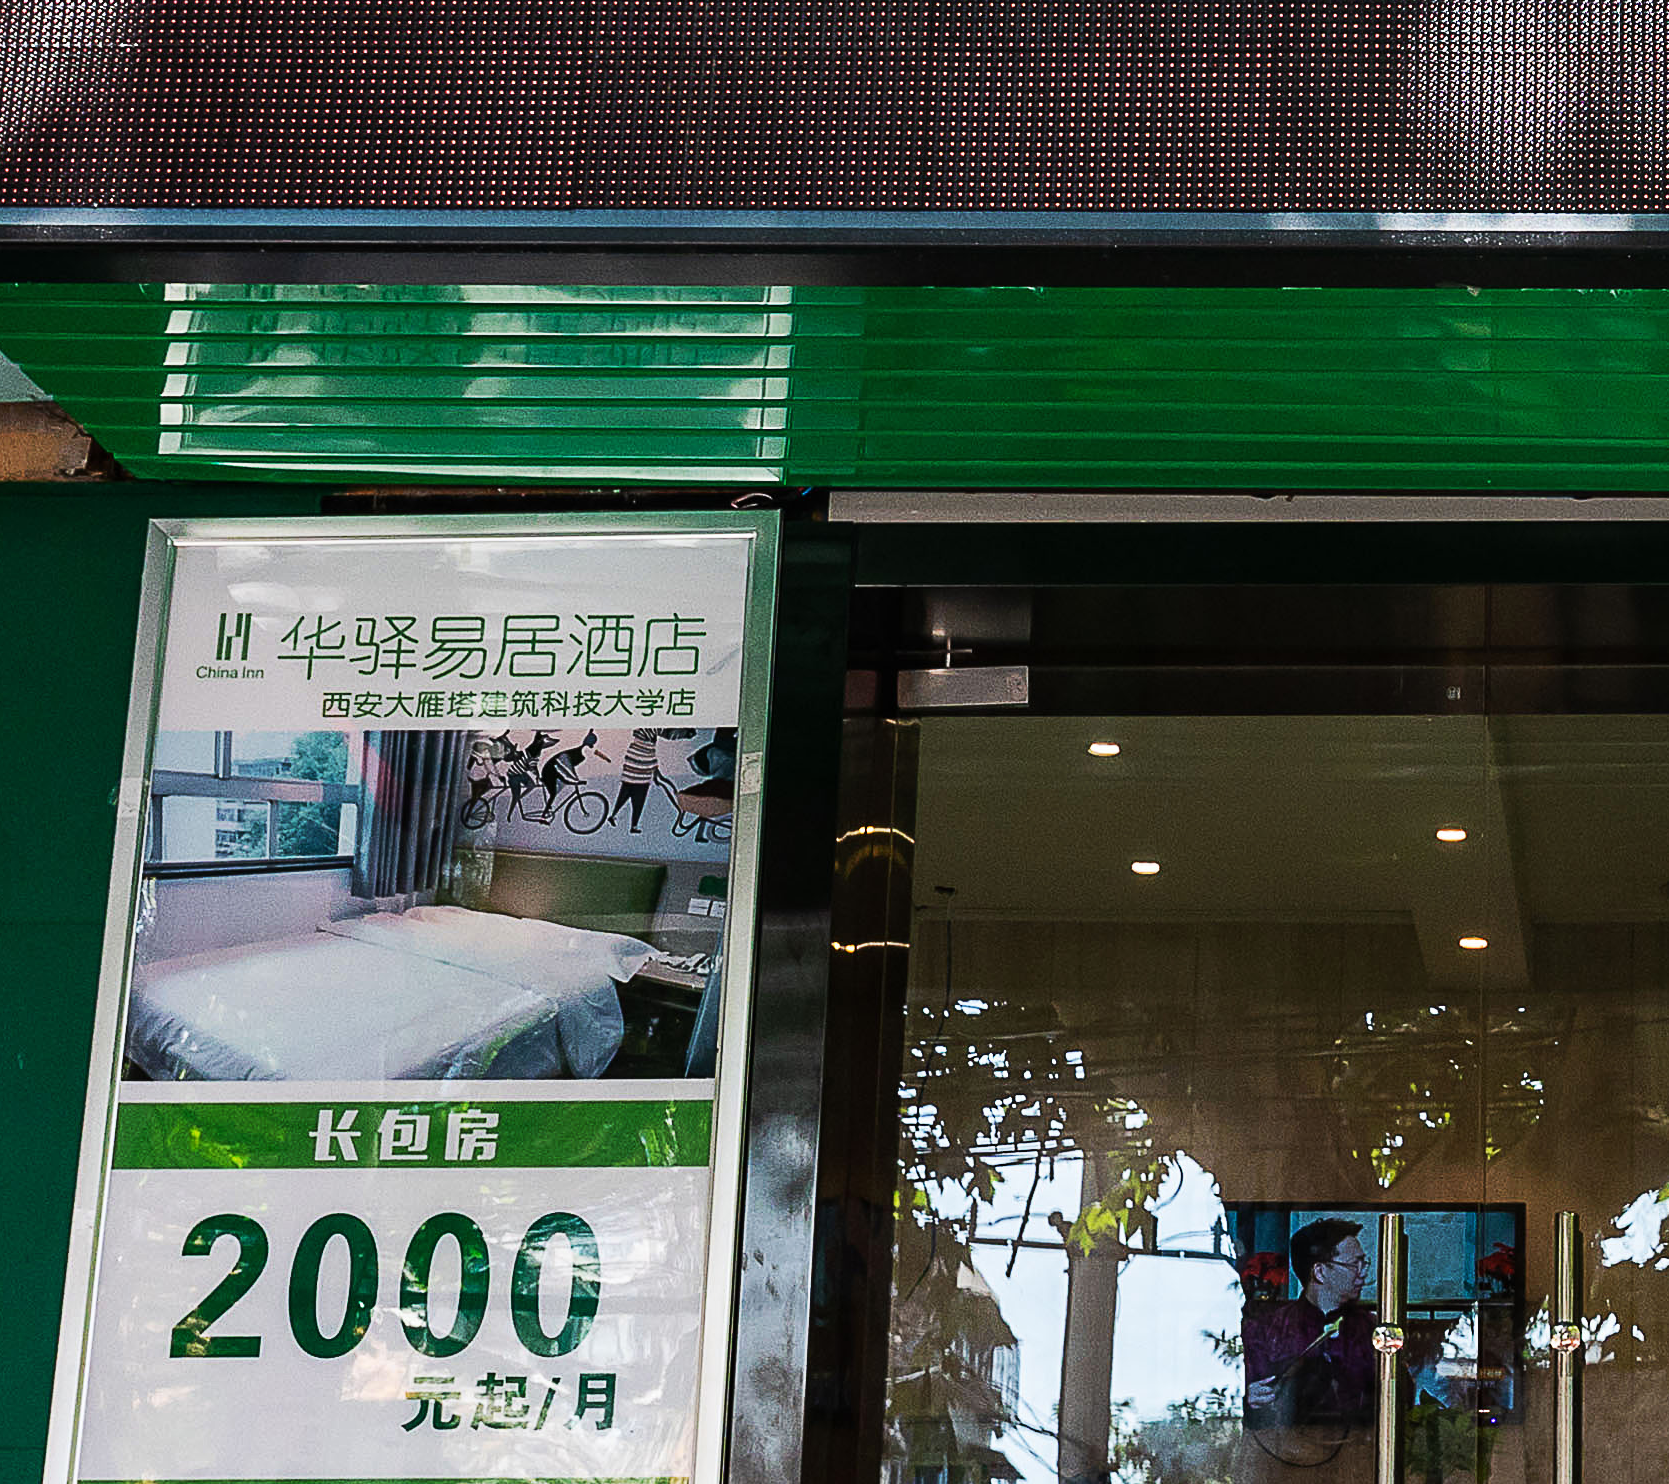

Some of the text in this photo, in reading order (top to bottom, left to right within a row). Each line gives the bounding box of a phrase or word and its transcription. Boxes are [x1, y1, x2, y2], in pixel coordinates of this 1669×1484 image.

[196, 665, 266, 681] China Inn
[276, 613, 708, 681] 华驿易居酒店
[321, 687, 697, 719] 西安大雁塔建筑科技大学店
[308, 1108, 501, 1162] 长包房
[169, 1211, 603, 1359] 2000
[400, 1372, 618, 1432] 元起/月
